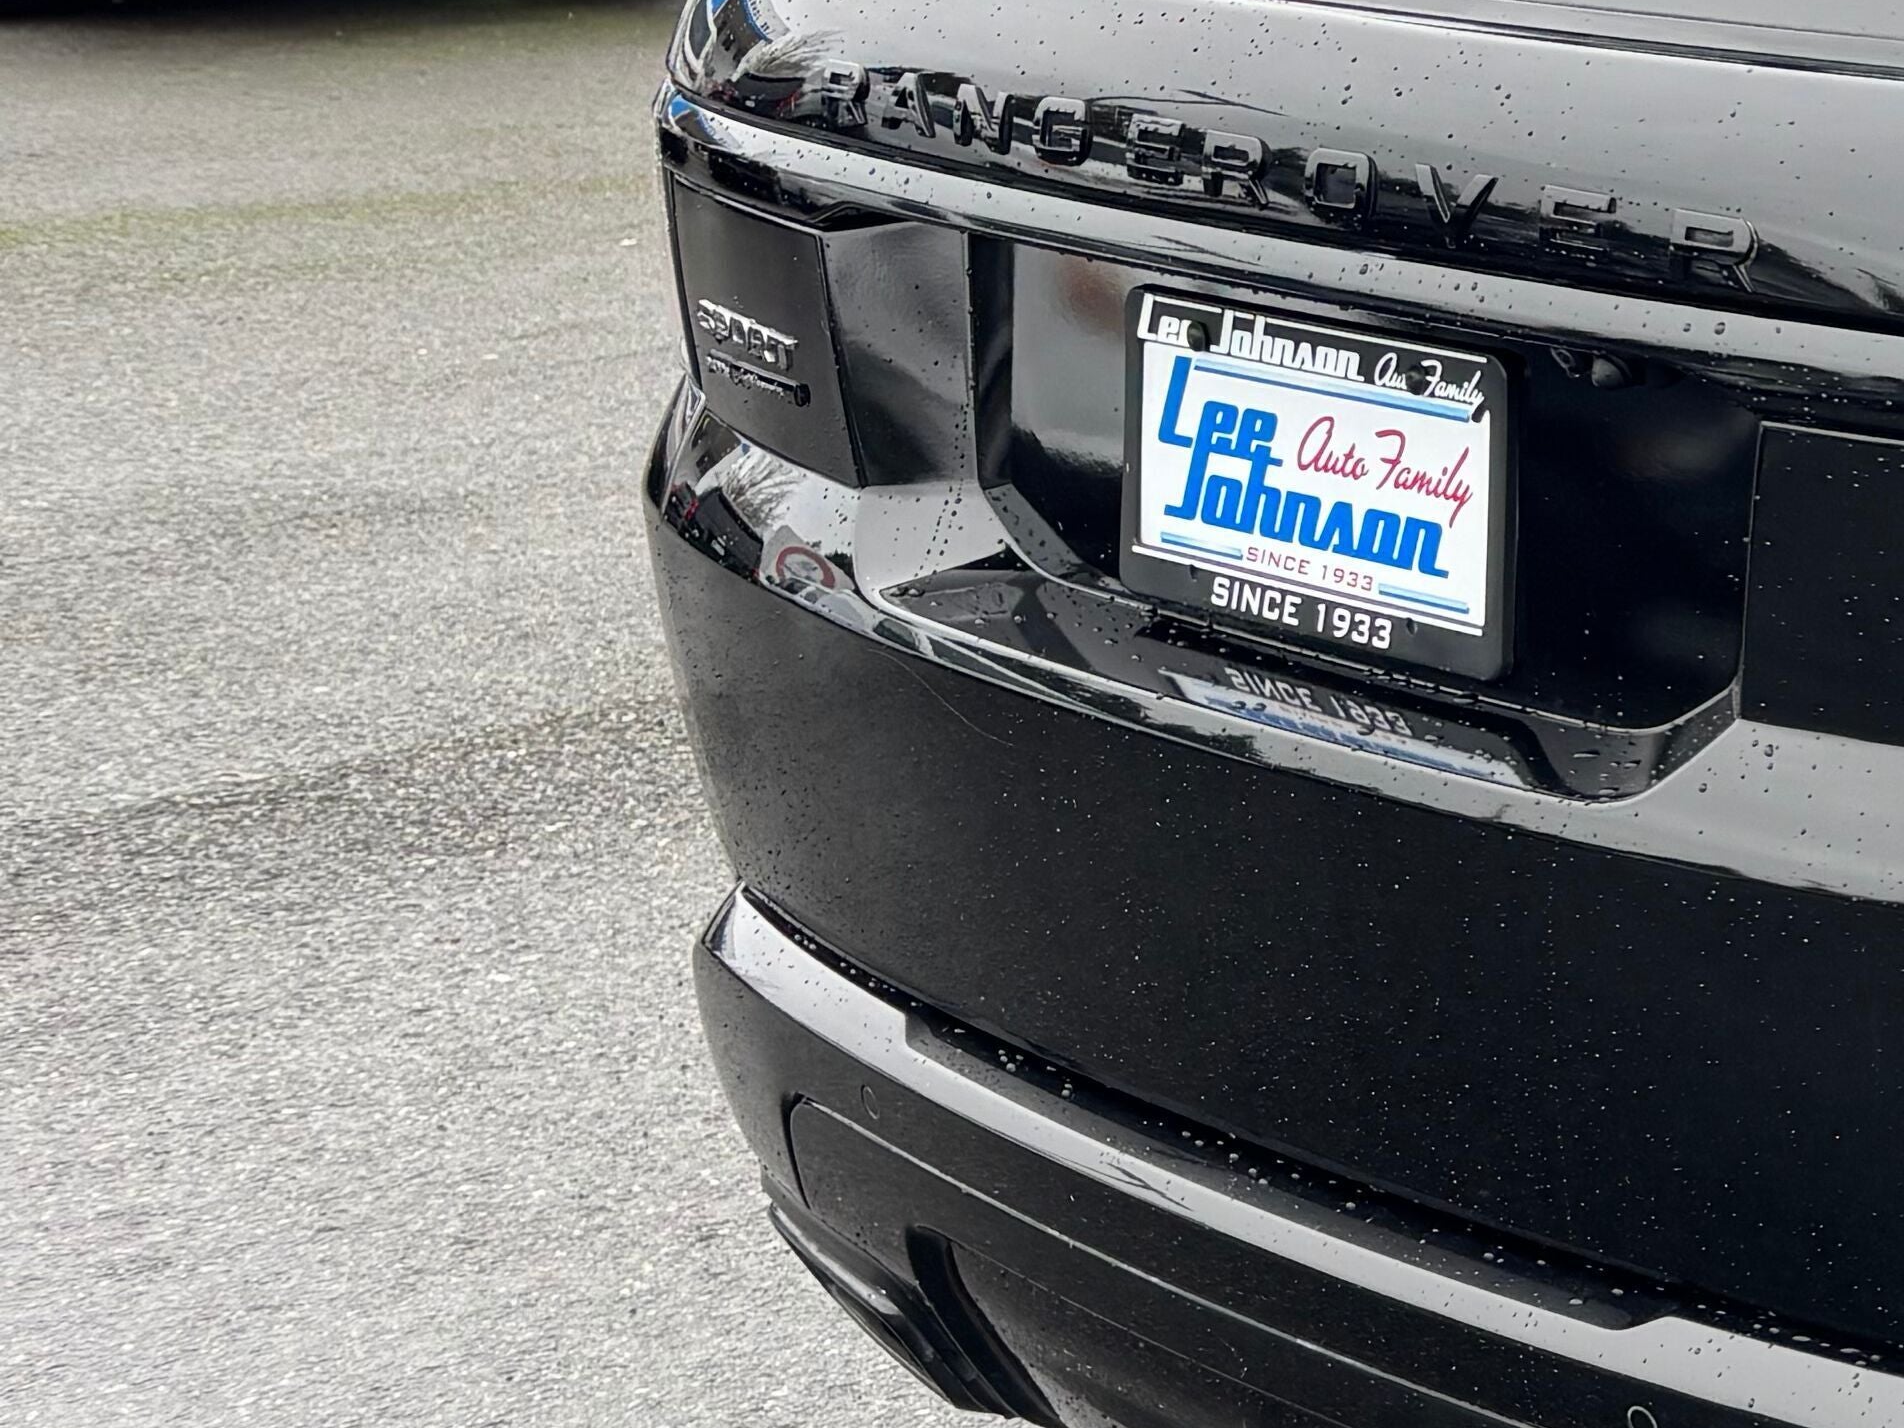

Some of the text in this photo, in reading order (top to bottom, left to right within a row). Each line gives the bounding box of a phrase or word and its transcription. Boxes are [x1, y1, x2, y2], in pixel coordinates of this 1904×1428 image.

[822, 59, 1760, 294] RANGE ROVER
[697, 298, 800, 371] SPORT
[1209, 308, 1364, 382] Johnson
[1421, 359, 1485, 412] Family
[1158, 356, 1474, 528] Lee Auto Family
[1163, 445, 1449, 578] Johnson
[1210, 576, 1393, 650] SINCE 1933
[1245, 546, 1373, 592] SINCE 1933
